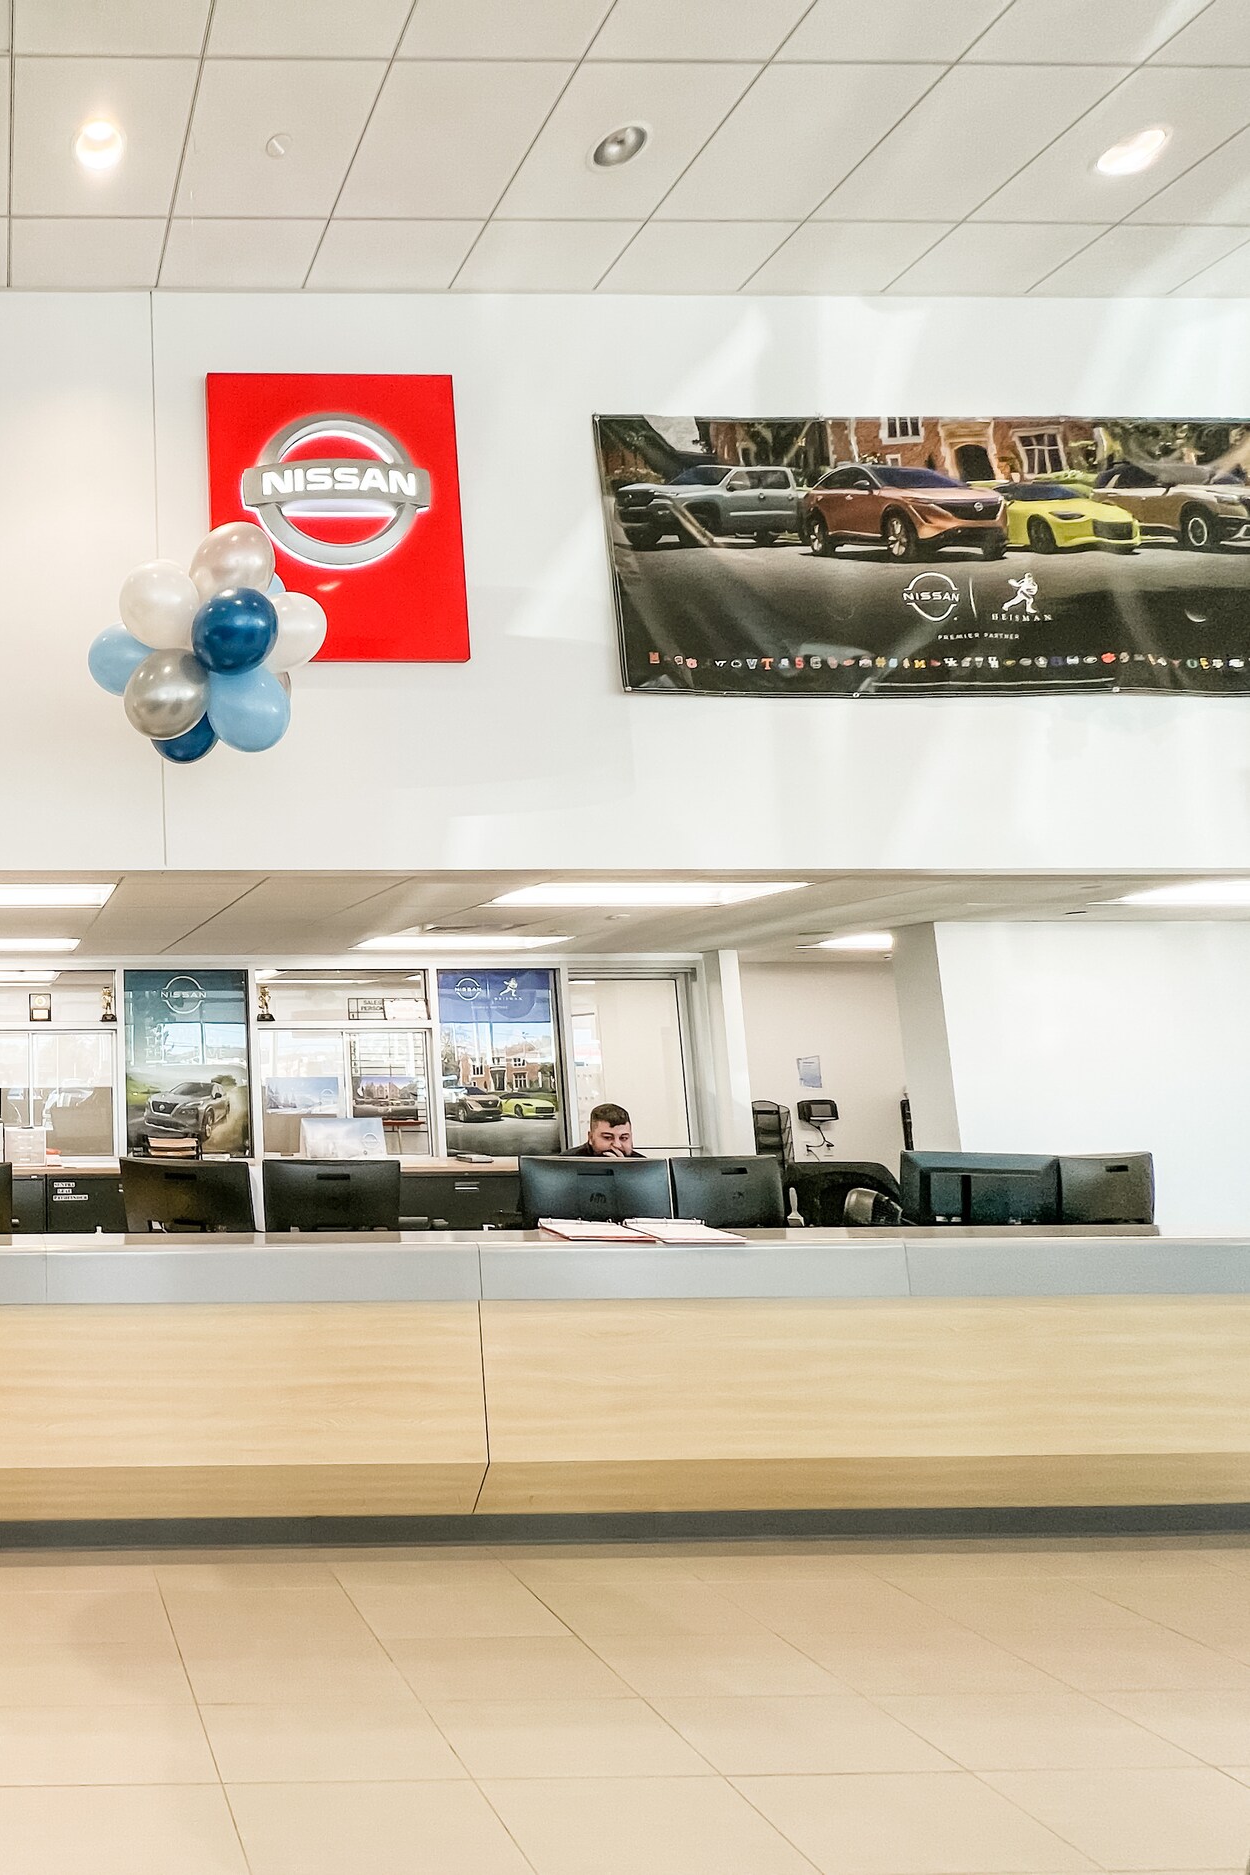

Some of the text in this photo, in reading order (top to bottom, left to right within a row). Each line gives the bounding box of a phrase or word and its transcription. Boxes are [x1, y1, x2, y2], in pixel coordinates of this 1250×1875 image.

[261, 467, 416, 497] NISSAN
[902, 591, 960, 602] NISSAN
[991, 613, 1054, 622] HEISMAN
[937, 632, 1020, 640] PREMIER PARTNER
